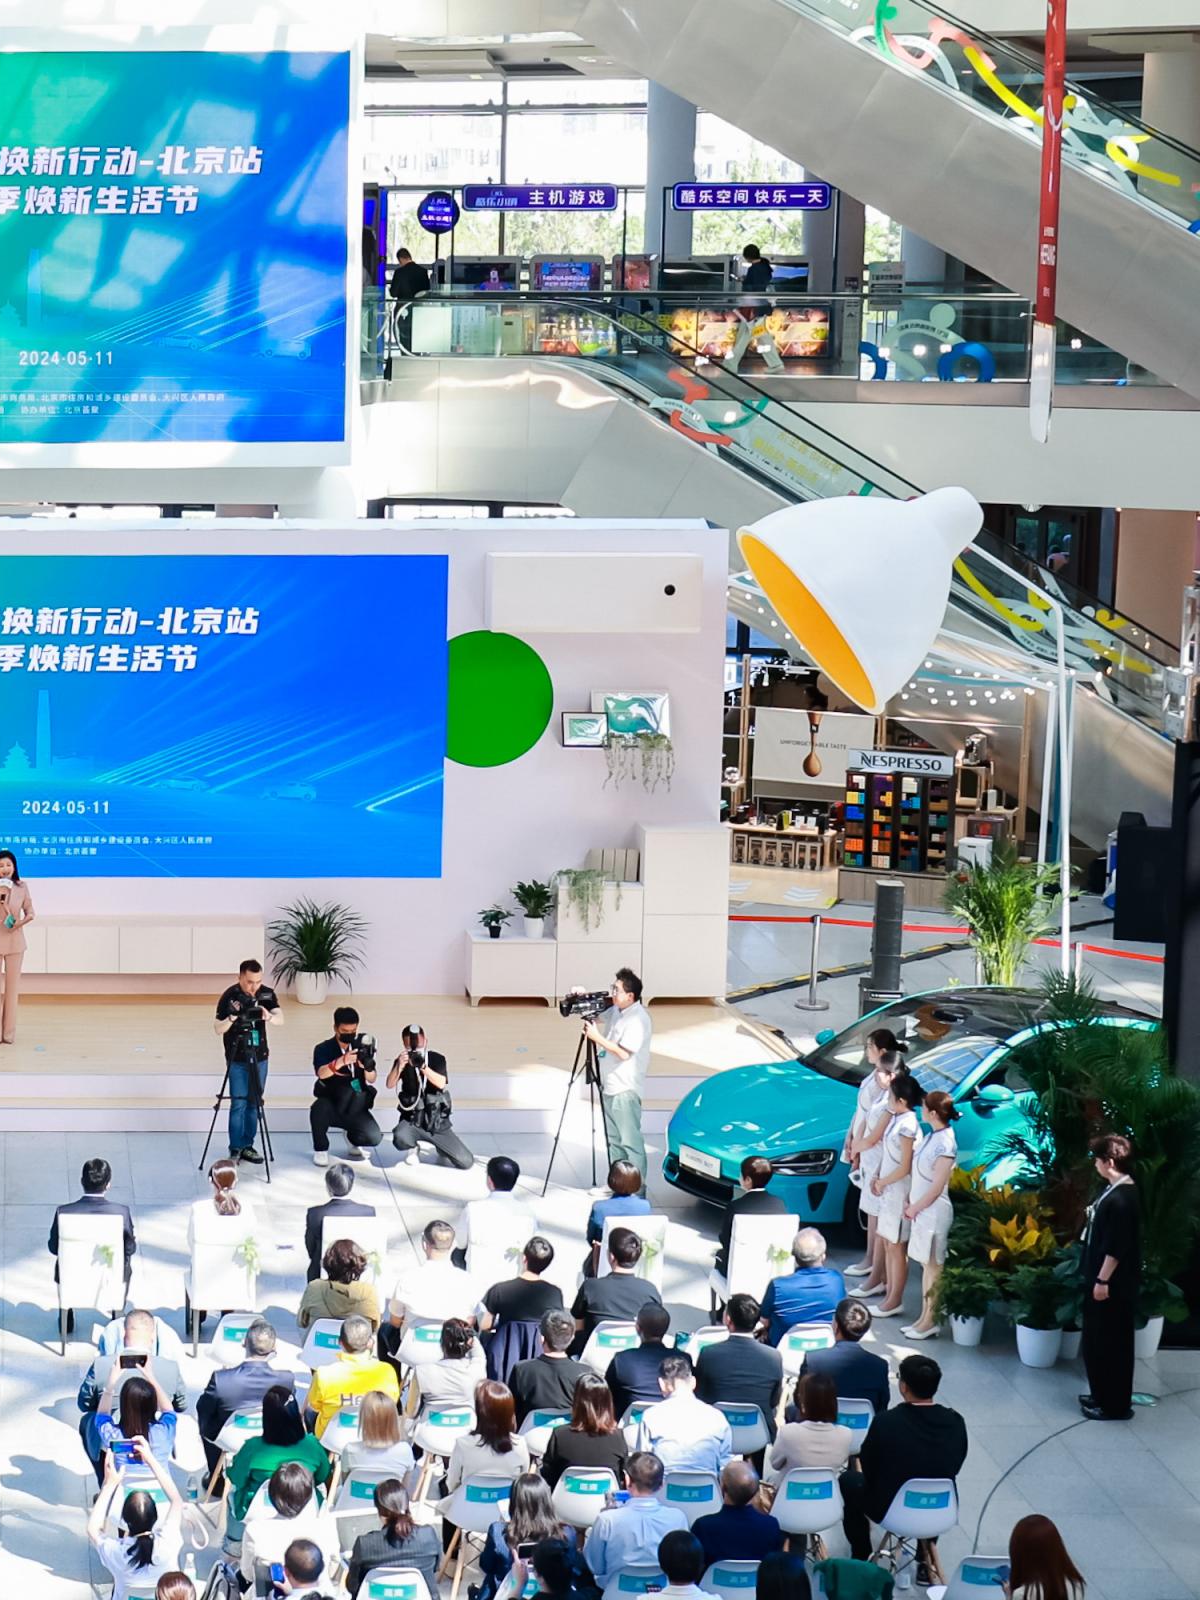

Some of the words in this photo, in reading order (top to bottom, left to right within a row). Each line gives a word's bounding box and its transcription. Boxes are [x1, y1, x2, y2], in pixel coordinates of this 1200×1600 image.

[528, 189, 606, 206] 主机游戏
[680, 189, 749, 204] 酷乐空间
[754, 189, 824, 204] 快乐一天
[860, 751, 942, 771] NESPRESSO
